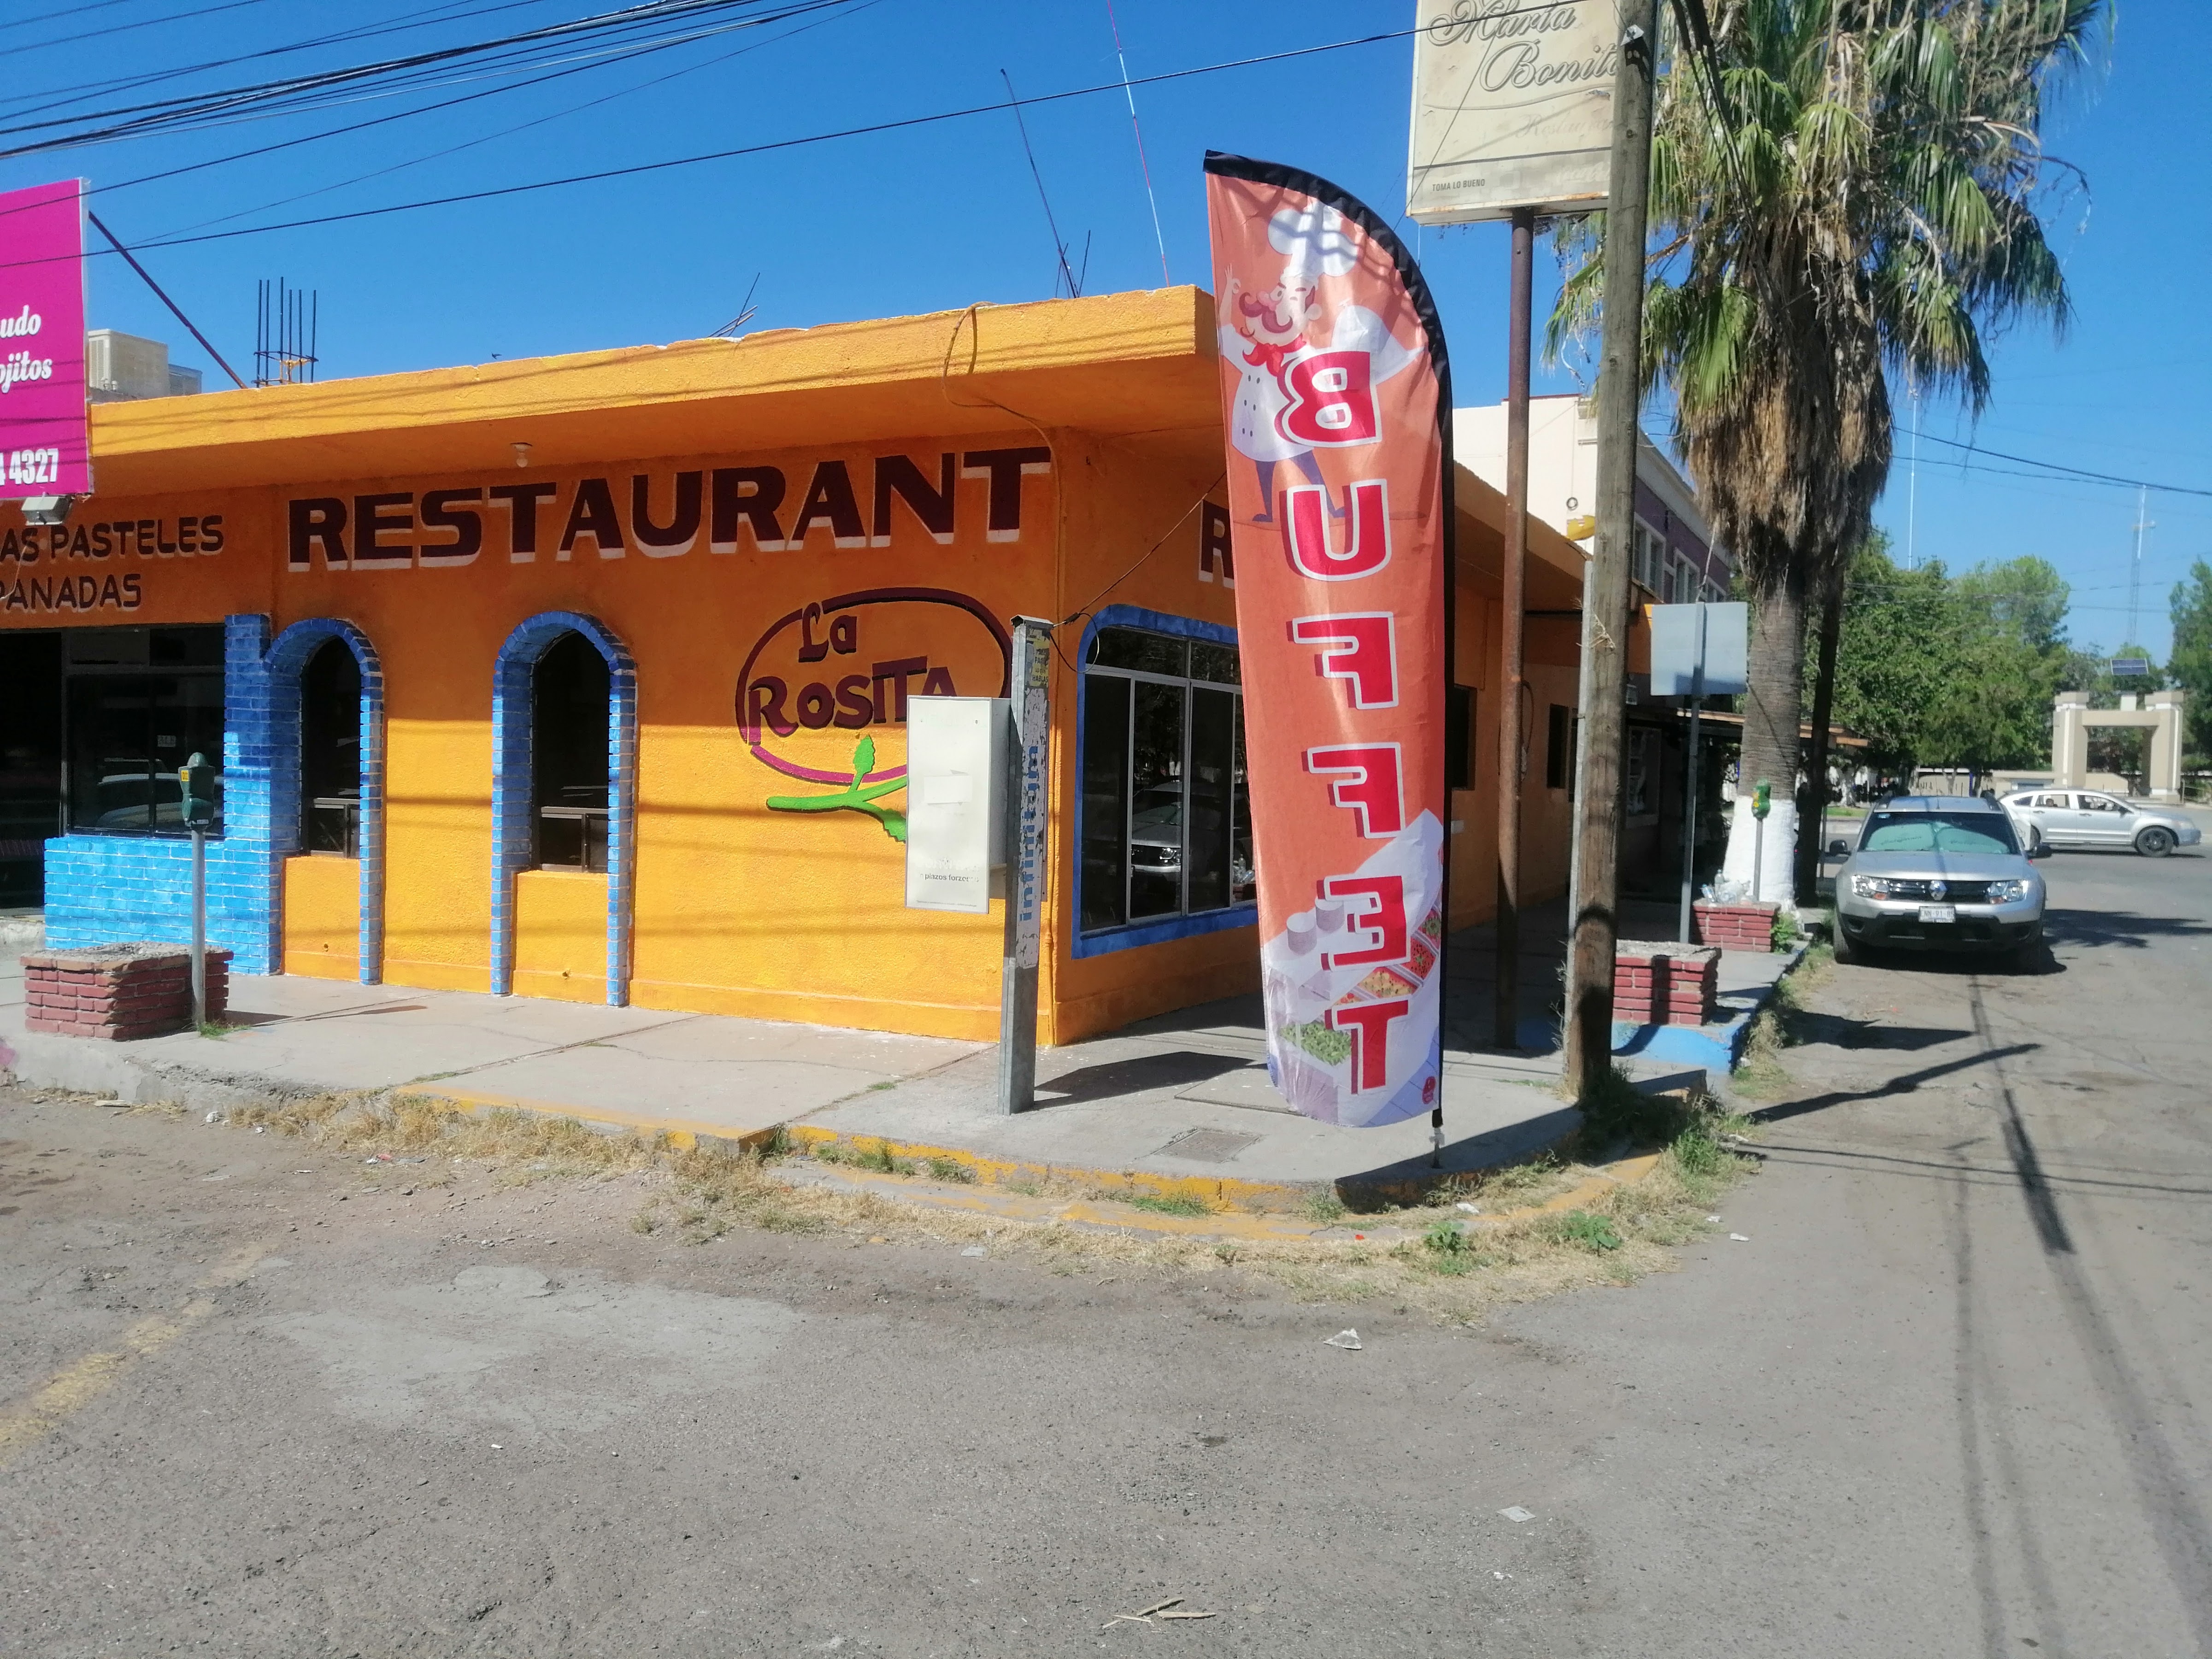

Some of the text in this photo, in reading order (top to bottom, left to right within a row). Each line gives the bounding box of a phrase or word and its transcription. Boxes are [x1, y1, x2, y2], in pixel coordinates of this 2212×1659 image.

[1432, 178, 1486, 191] TOMA LO BUENO
[9, 447, 59, 486] 4327
[288, 446, 1052, 572] RESTAURANT
[50, 515, 224, 564] PASTELES
[0, 573, 142, 613] ANADAS
[798, 602, 858, 663] La
